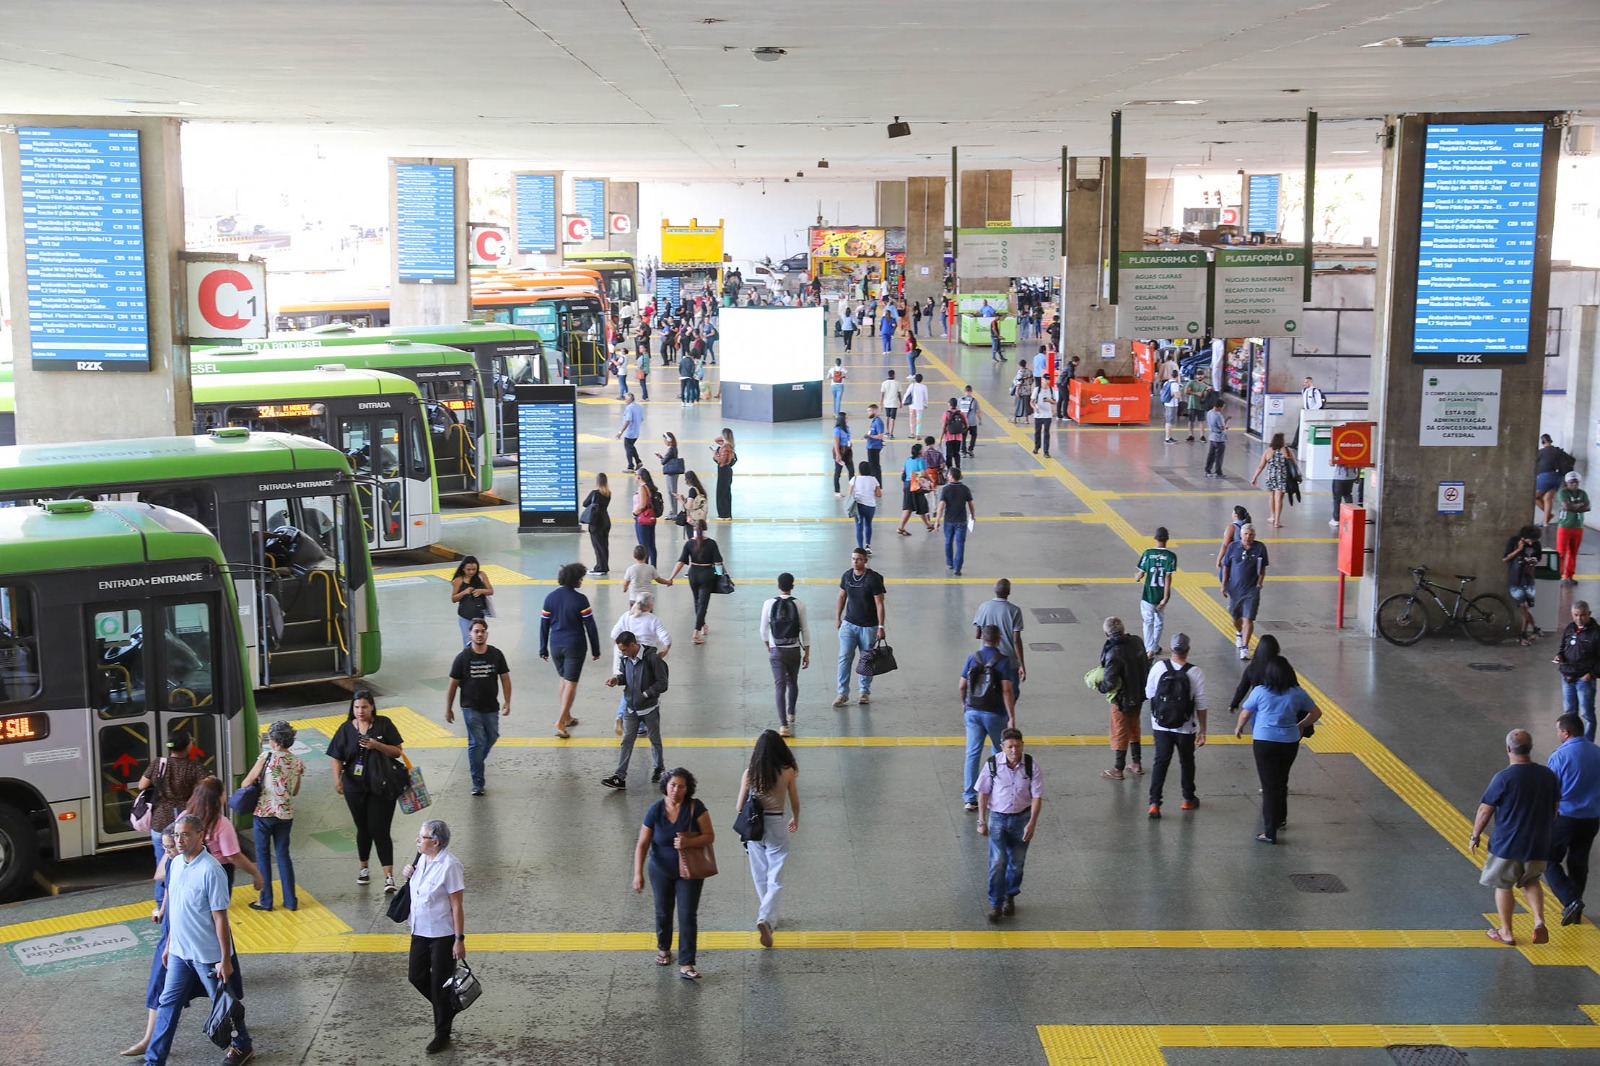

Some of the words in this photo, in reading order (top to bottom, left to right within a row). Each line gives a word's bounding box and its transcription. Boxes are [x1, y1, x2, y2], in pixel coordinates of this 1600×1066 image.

[1129, 256, 1187, 264] PLATAFORMA
[1189, 254, 1198, 262] C
[1286, 253, 1295, 261] D
[272, 340, 323, 350] BIODIESEL
[77, 361, 104, 370] RZK
[359, 402, 391, 410] ENTRADA
[259, 405, 275, 418] 324
[259, 483, 292, 491] ENTRADA
[296, 480, 334, 488] ENTRANCE
[99, 579, 145, 590] ENTRADA
[151, 572, 202, 585] ENTRANCE
[6, 717, 35, 738] SUL
[21, 942, 58, 953] FILA
